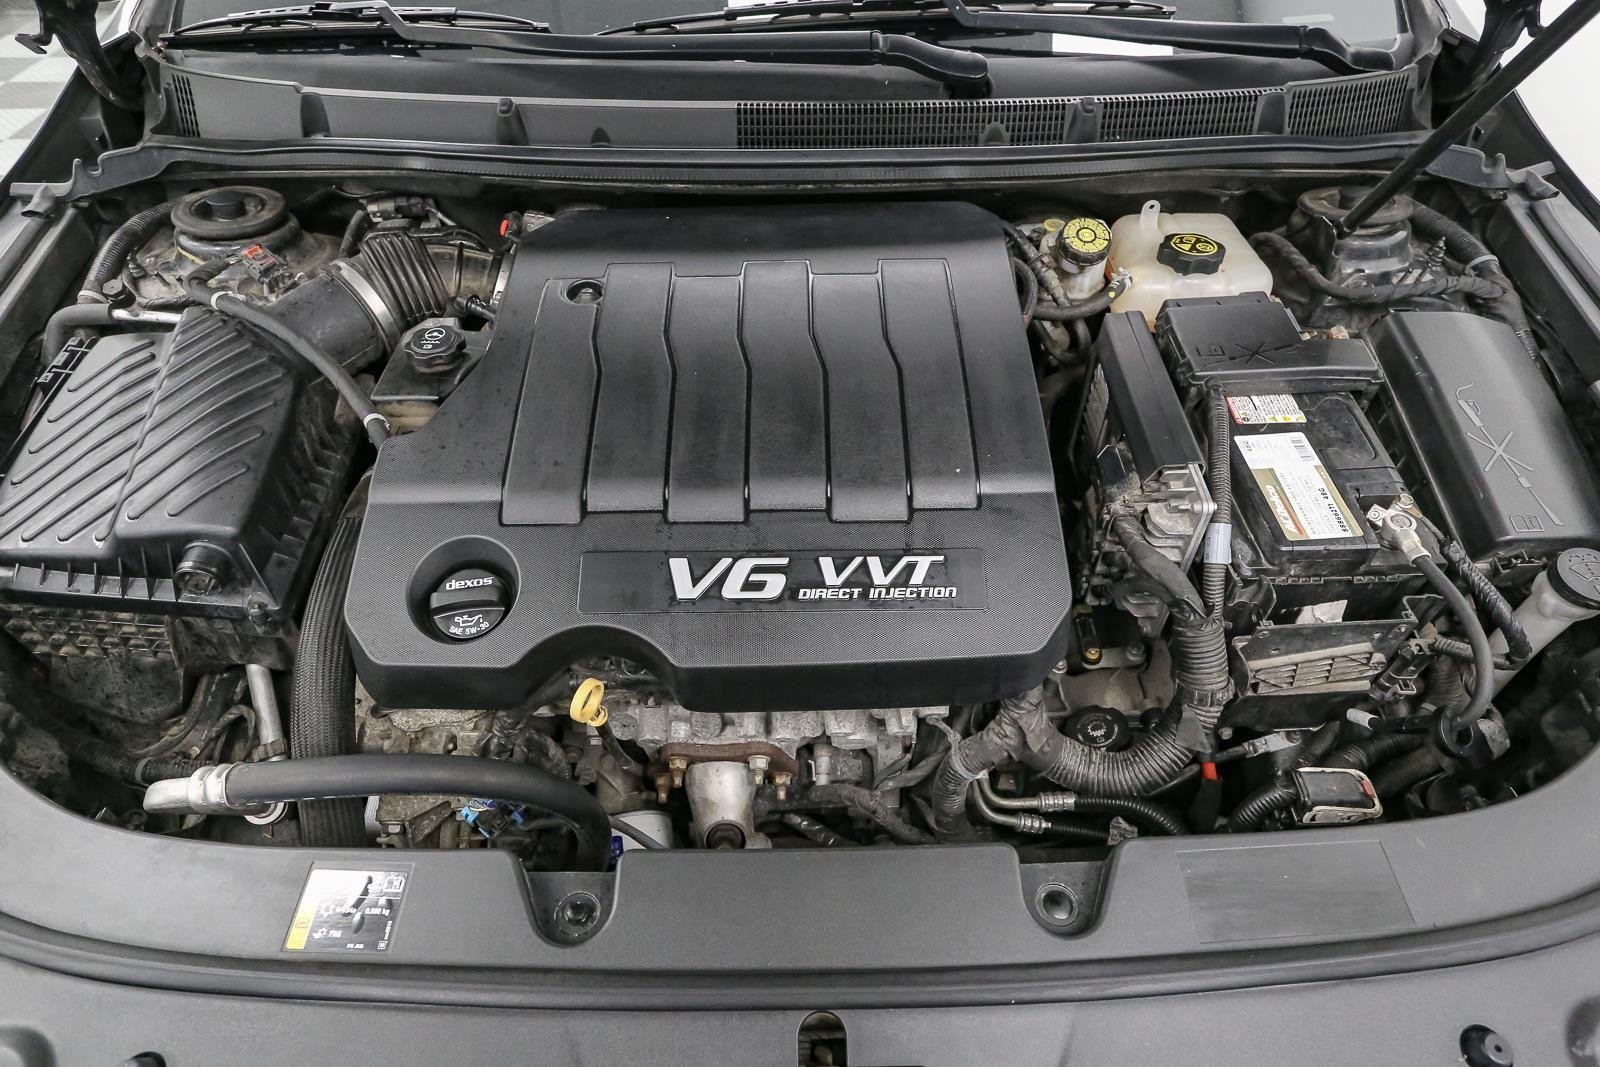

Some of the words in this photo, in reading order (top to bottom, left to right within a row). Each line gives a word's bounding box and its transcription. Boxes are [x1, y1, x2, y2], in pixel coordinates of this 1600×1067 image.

[445, 576, 495, 591] dexos
[668, 557, 790, 601] V6
[818, 556, 945, 587] VVT
[798, 587, 863, 600] DIRECT
[868, 586, 957, 600] INJECTION
[448, 625, 463, 635] SAE
[465, 621, 490, 635] 5W-30
